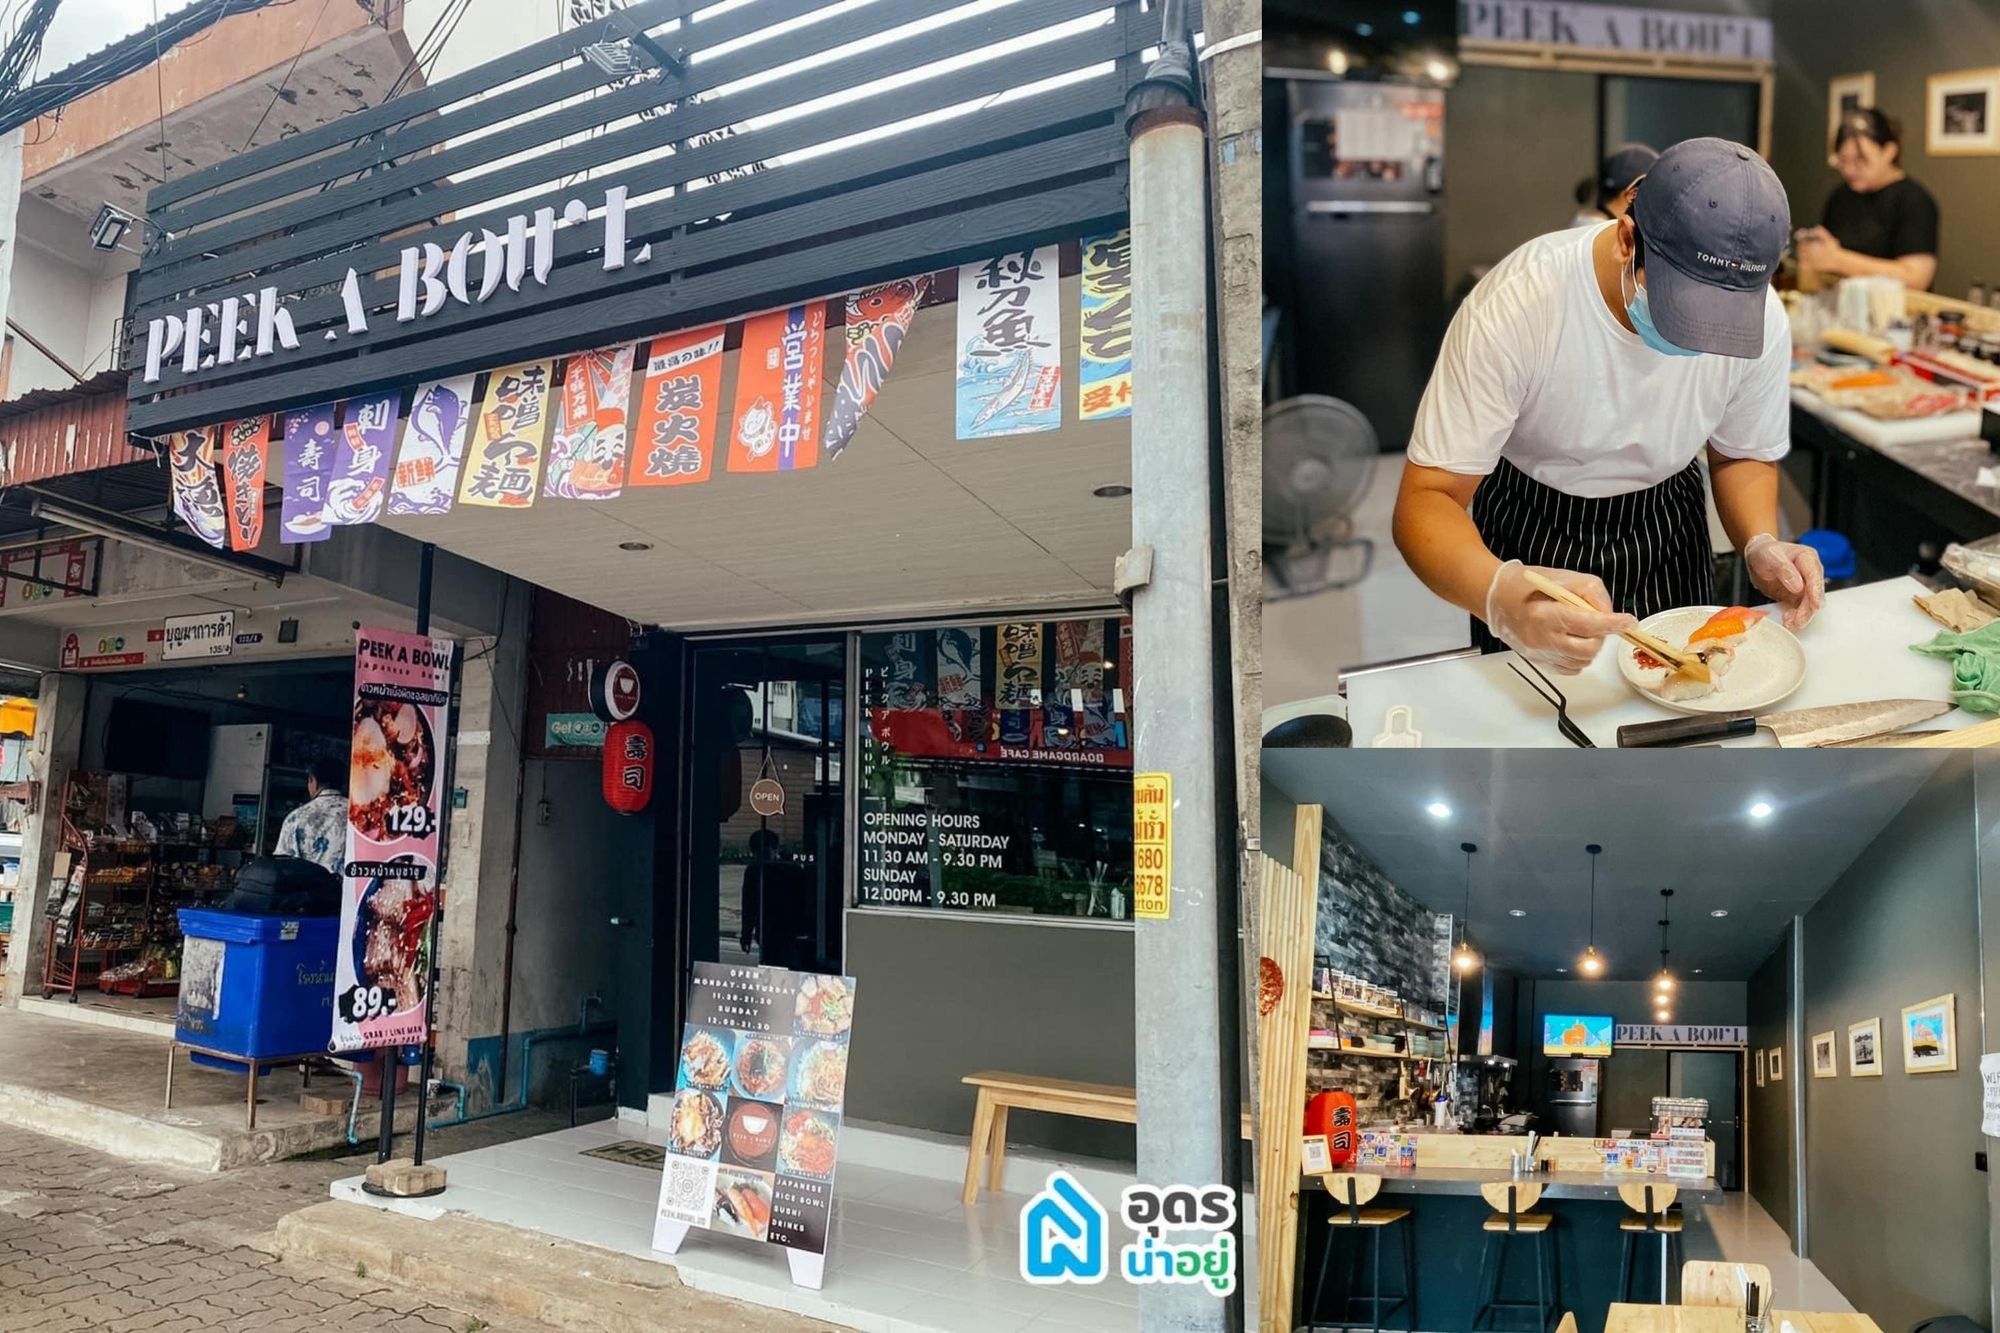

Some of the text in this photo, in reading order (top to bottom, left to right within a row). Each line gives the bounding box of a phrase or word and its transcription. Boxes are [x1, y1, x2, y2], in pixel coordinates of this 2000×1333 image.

[1696, 251, 1731, 267] TOMMY
[144, 286, 300, 383] PEEK
[325, 267, 369, 340] A
[778, 319, 808, 458] 営業中
[347, 398, 390, 476] 刺身
[358, 638, 450, 671] PEEK A BOWL
[755, 791, 780, 802] OPEN
[864, 812, 980, 829] OPENING HOURS
[863, 831, 925, 846] MONDAY
[938, 833, 1010, 850] SATURDAY
[863, 849, 902, 865] 11.30
[905, 851, 929, 865] AM
[943, 852, 976, 868] 9.30
[980, 854, 1003, 869] PM
[1135, 848, 1164, 869] 680
[863, 868, 917, 884] SUNDAY
[863, 886, 923, 903] 12.00PM
[936, 890, 970, 906] 9.30
[973, 891, 996, 907] PM
[730, 969, 760, 979] OPEN
[718, 1005, 760, 1017] SUNDAY
[363, 1030, 383, 1040] GRAB
[390, 1027, 405, 1037] LINE
[407, 1025, 423, 1035] MAN
[1616, 1025, 1662, 1041] PEEK
[1669, 1028, 1680, 1041] A
[777, 1178, 822, 1194] JAPANESE
[775, 1191, 825, 1209] RICE BOWL
[774, 1204, 801, 1217] SUSHI
[771, 1218, 805, 1232] DRINKS
